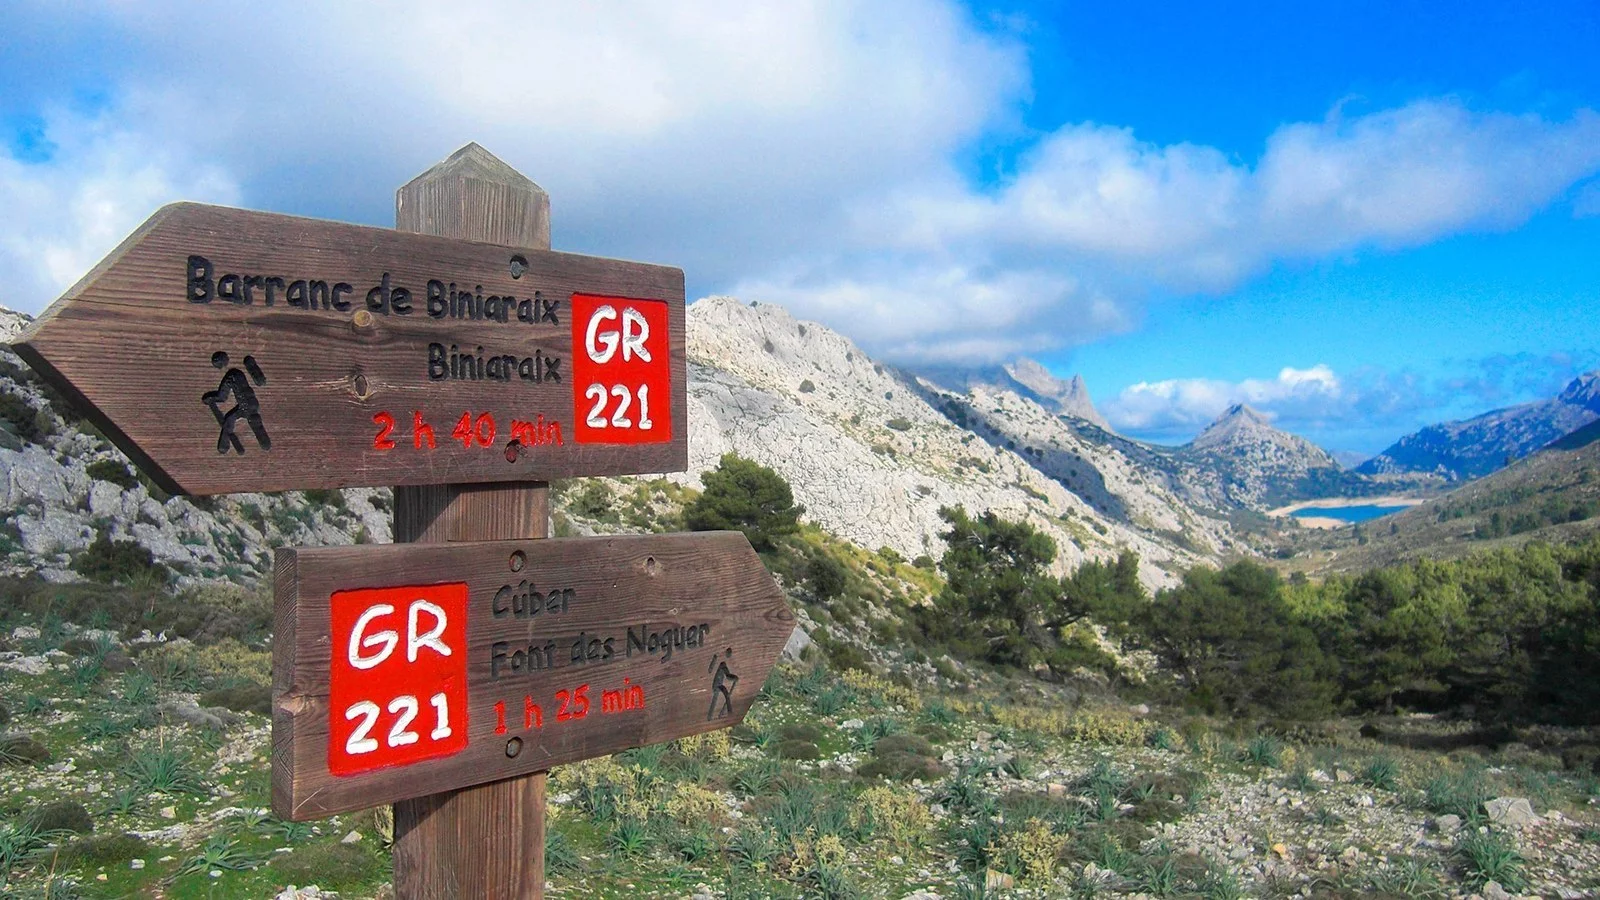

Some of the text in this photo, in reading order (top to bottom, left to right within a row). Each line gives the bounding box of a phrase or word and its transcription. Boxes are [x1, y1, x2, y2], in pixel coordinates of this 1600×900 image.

[187, 254, 560, 325] Barranc de Biniaraix
[428, 342, 562, 384] Biniaraix
[584, 304, 653, 364] GR
[373, 410, 564, 451] 2 h 40 min
[585, 382, 653, 431] 221
[492, 579, 576, 619] Cúber
[347, 599, 452, 670] GR
[491, 620, 710, 679] Font des Noguer
[344, 691, 452, 755] 221
[493, 677, 645, 735] 1 h 25 min
